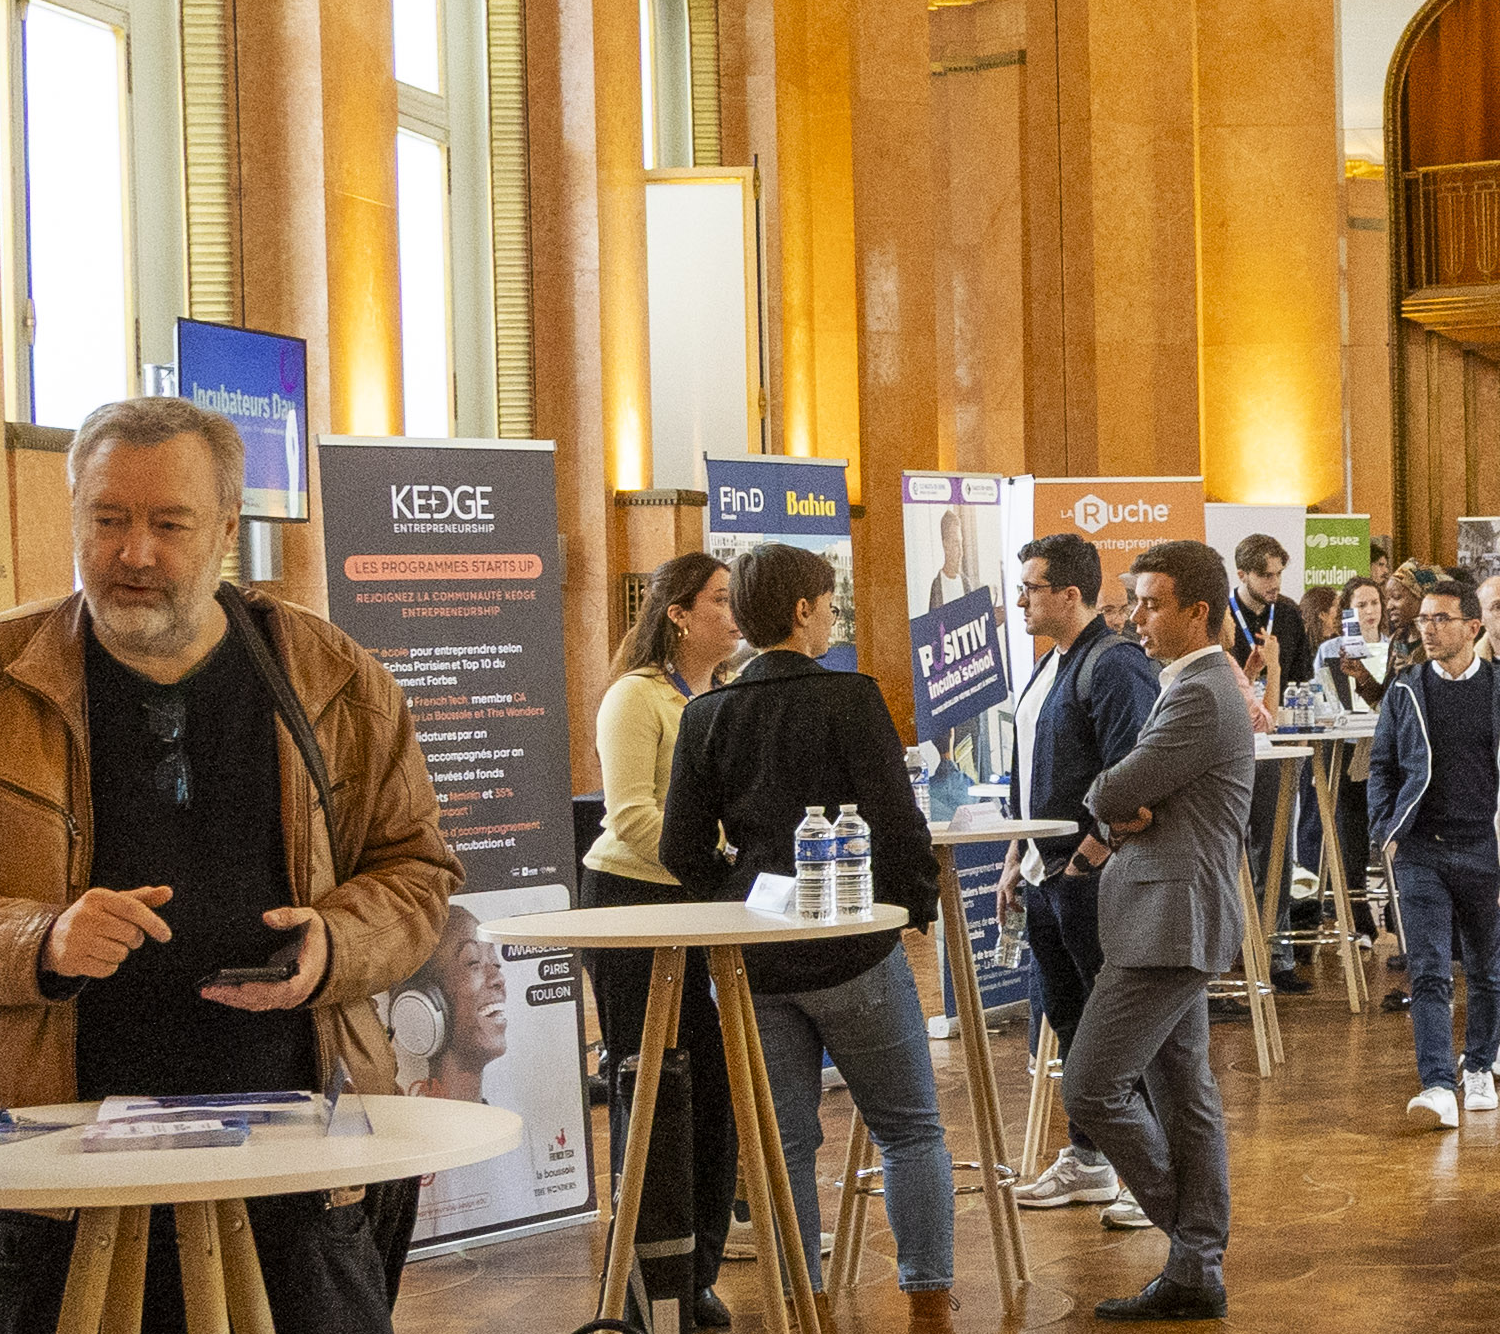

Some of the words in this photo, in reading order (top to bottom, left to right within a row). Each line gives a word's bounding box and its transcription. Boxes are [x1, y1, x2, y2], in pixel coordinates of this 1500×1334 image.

[193, 382, 270, 418] Incubateurs
[391, 485, 494, 520] KEDGE
[786, 491, 836, 516] Bahia
[1078, 498, 1169, 528] Ruche
[394, 523, 495, 534] ENTREPRENEURSHIP
[355, 560, 379, 574] LES
[382, 560, 469, 574] PROGRAMMES
[472, 559, 515, 573] STARTS
[519, 560, 535, 573] UP
[356, 591, 415, 604] REJOIGNEZ
[417, 592, 430, 603] LA
[432, 589, 502, 602] COMMUNAUTÉ
[504, 590, 536, 601] KEDGE
[402, 605, 500, 618] ENTREPRENEURSHIP
[410, 647, 433, 659] pour
[434, 643, 496, 657] entreprendre
[498, 643, 522, 654] selon
[414, 660, 450, 671] Parisien
[451, 660, 461, 670] et
[462, 659, 479, 671] Top
[481, 659, 491, 669] 10
[493, 658, 506, 669] du
[426, 675, 457, 686] Forbes
[471, 693, 512, 705] membre
[435, 709, 472, 721] Boussole
[487, 707, 504, 717] The
[506, 705, 545, 717] Wonders
[458, 730, 472, 741] par
[474, 729, 487, 739] an
[428, 750, 492, 762] accompagnés
[494, 749, 509, 760] par
[512, 747, 524, 757] an
[434, 771, 462, 782] levées
[464, 770, 475, 780] de
[476, 768, 504, 779] fonds
[482, 789, 493, 799] et
[456, 839, 504, 851] incubation
[505, 837, 516, 847] et
[543, 962, 570, 976] PARIS
[531, 986, 571, 1001] TOULON
